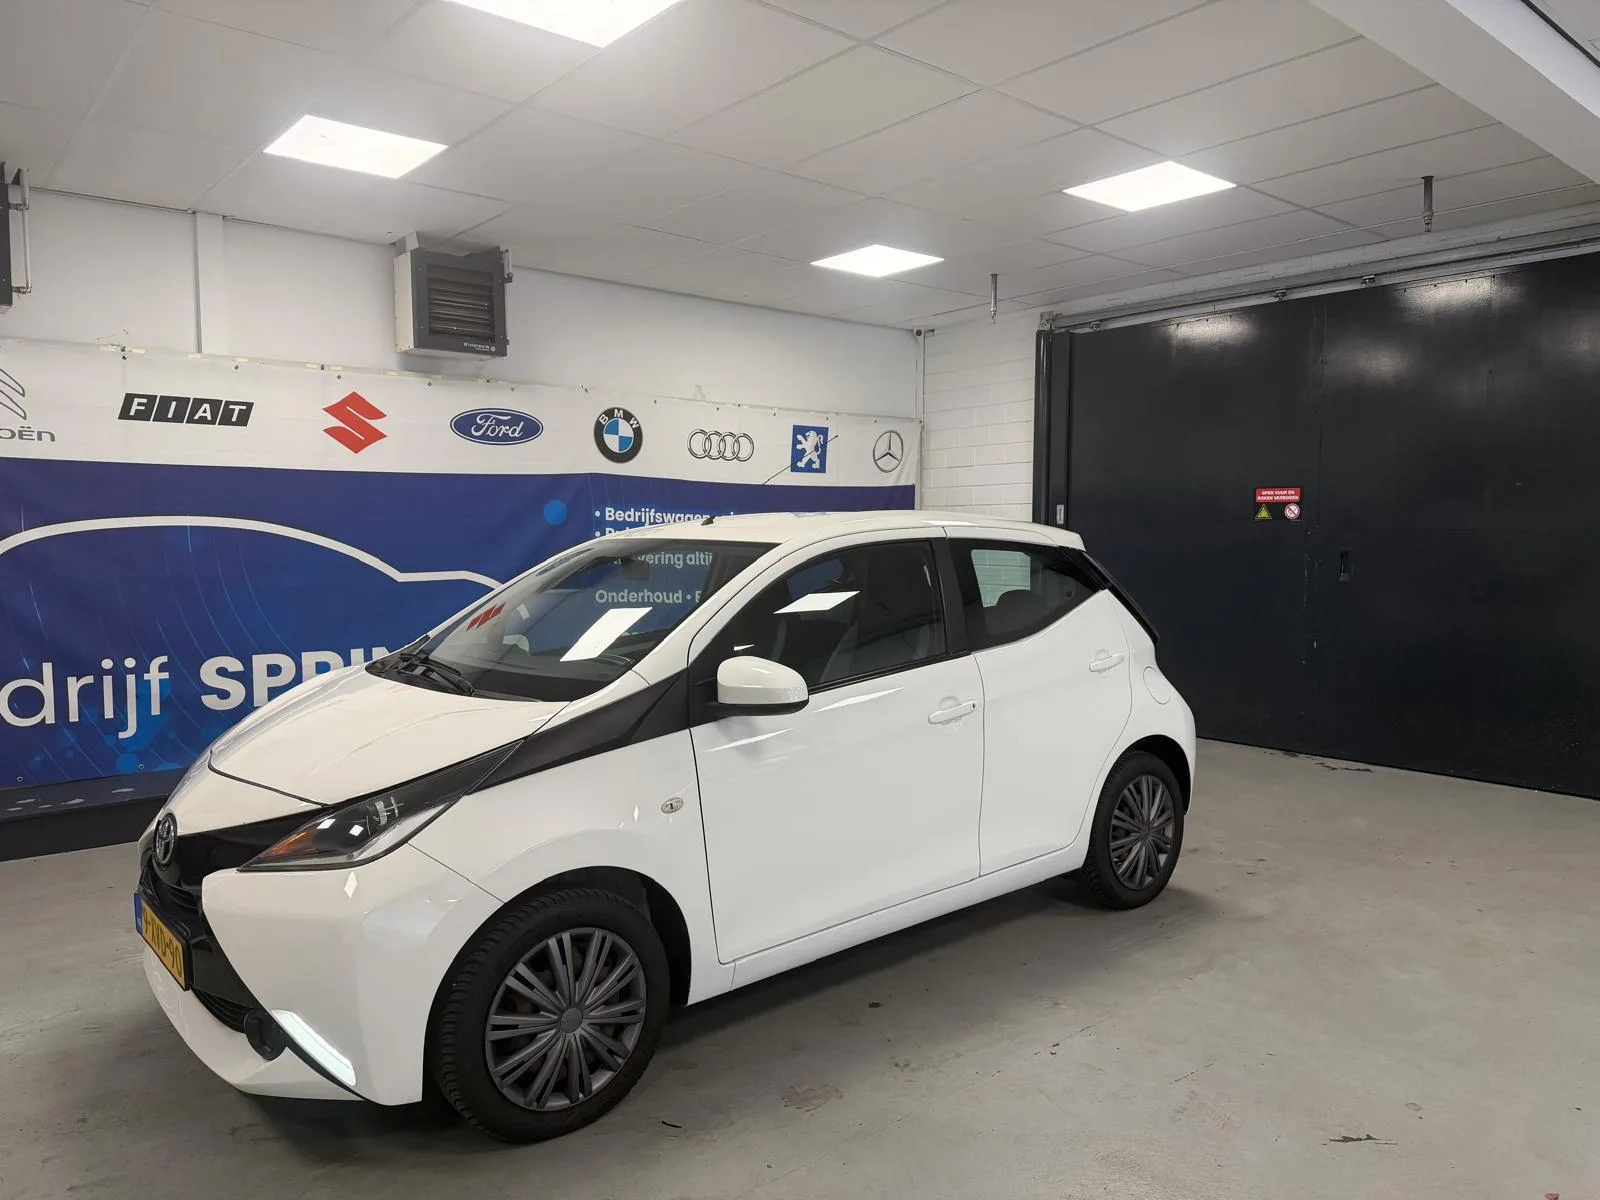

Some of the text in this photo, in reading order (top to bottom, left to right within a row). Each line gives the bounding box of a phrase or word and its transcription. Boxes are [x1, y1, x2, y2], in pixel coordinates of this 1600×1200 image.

[126, 396, 250, 423] FIAT
[599, 409, 639, 428] BMW
[471, 413, 525, 437] Ford
[595, 588, 683, 604] Onderhoud
[0, 655, 170, 739] drijf
